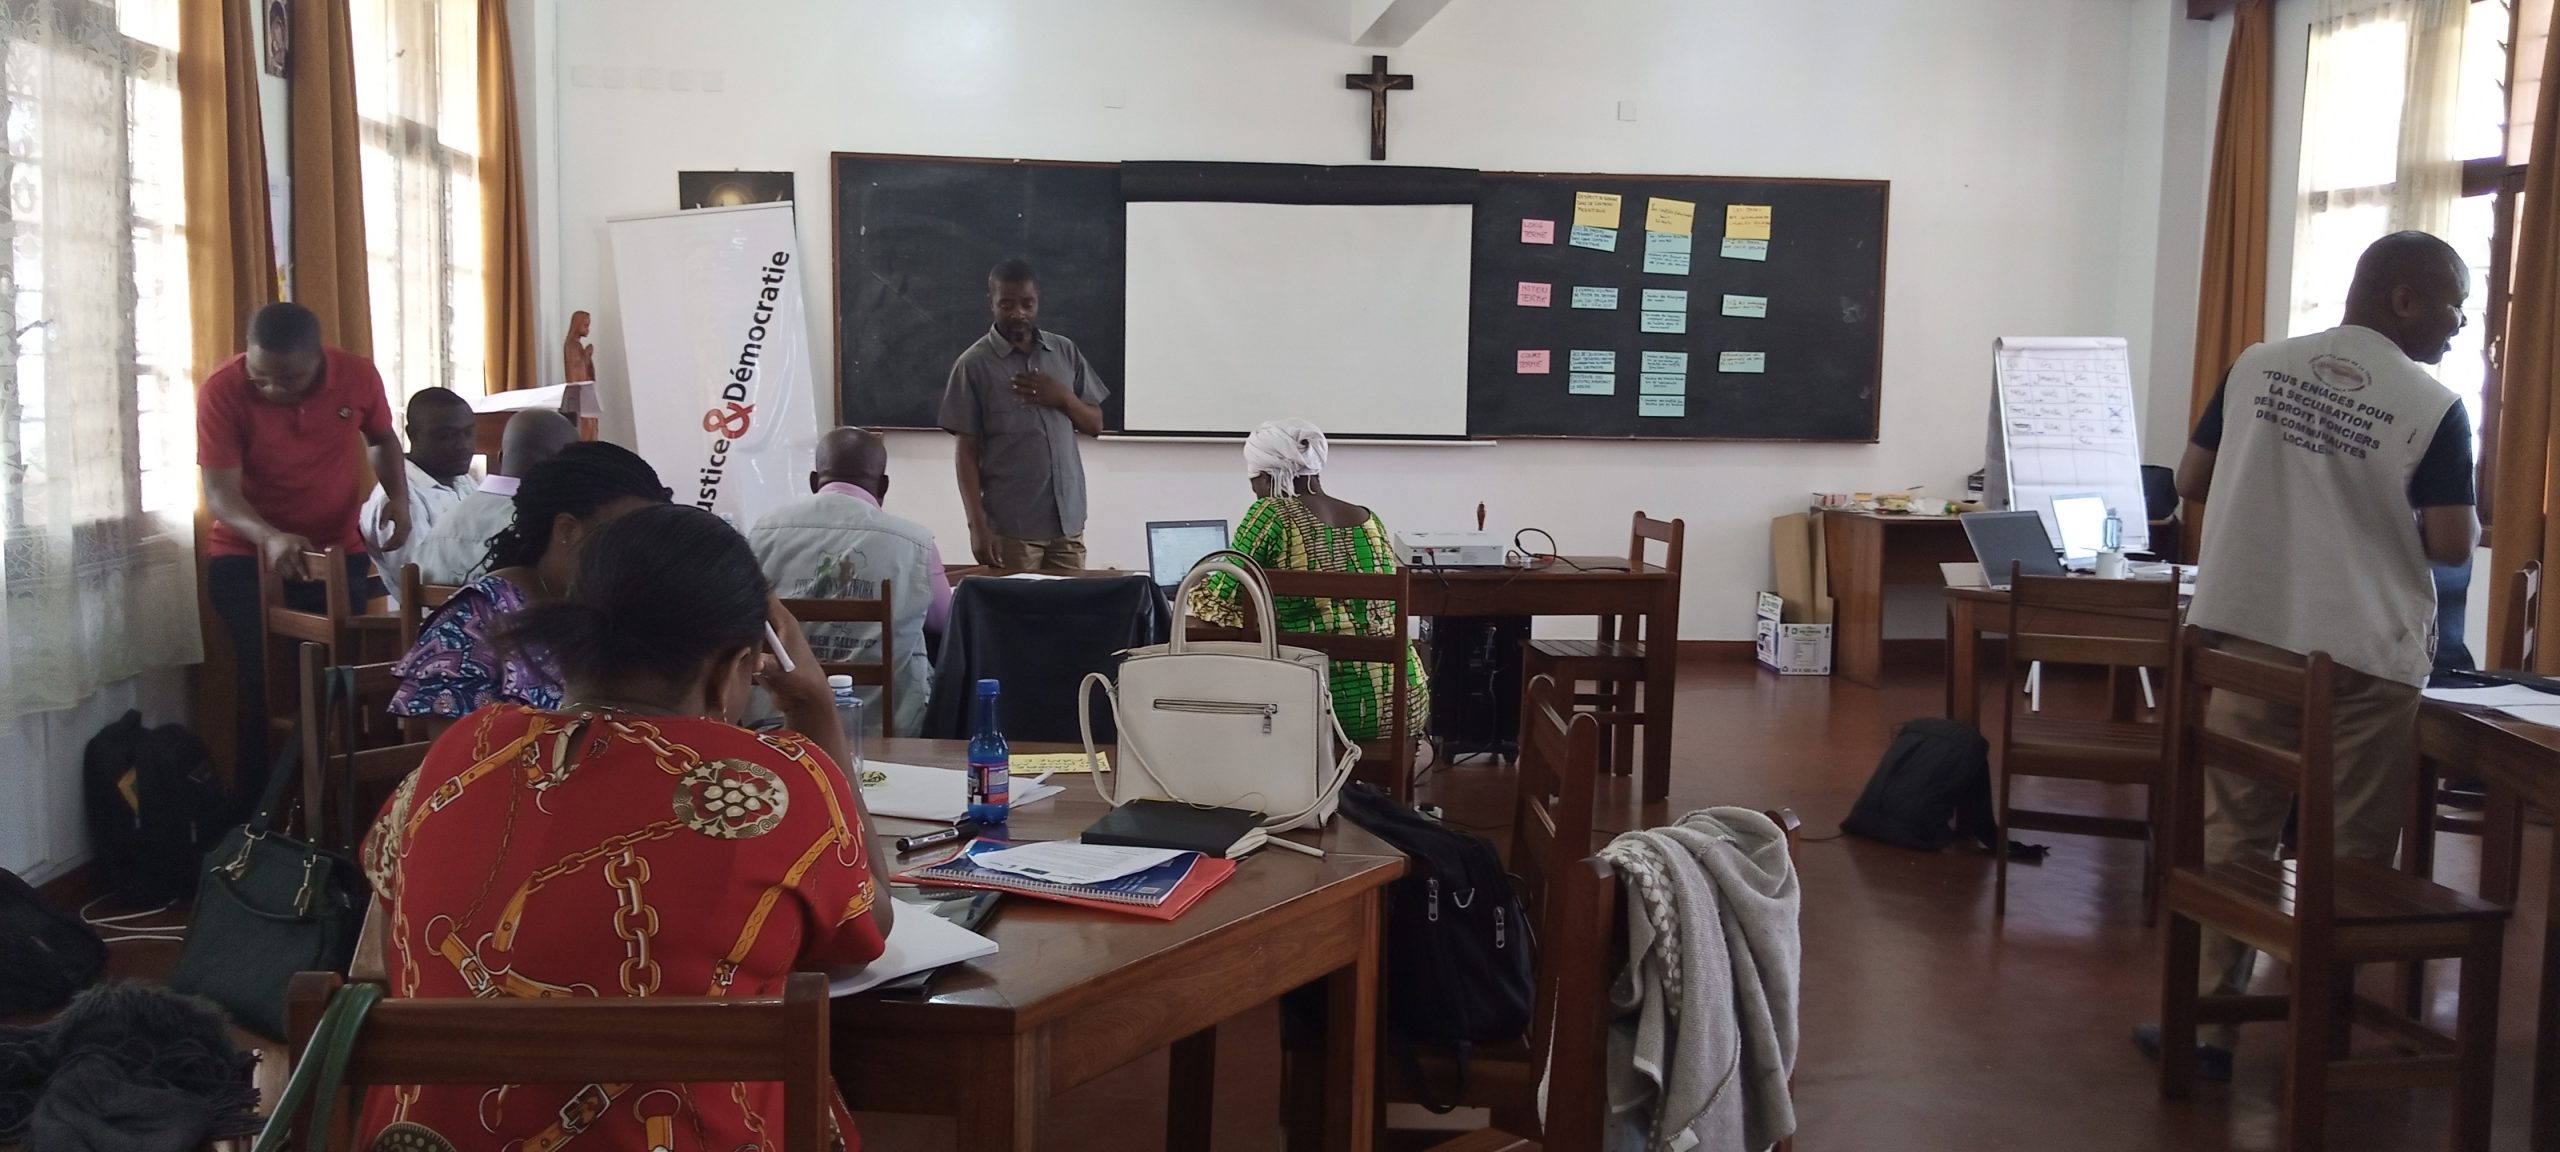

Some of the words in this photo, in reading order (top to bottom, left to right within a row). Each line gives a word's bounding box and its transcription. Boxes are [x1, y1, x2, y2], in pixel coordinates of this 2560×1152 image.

[2269, 383, 2284, 397] LA
[2254, 396, 2275, 408] DES
[2319, 416, 2380, 449] FONCIERS
[2255, 409, 2278, 423] DES
[2357, 403, 2394, 425] POUR
